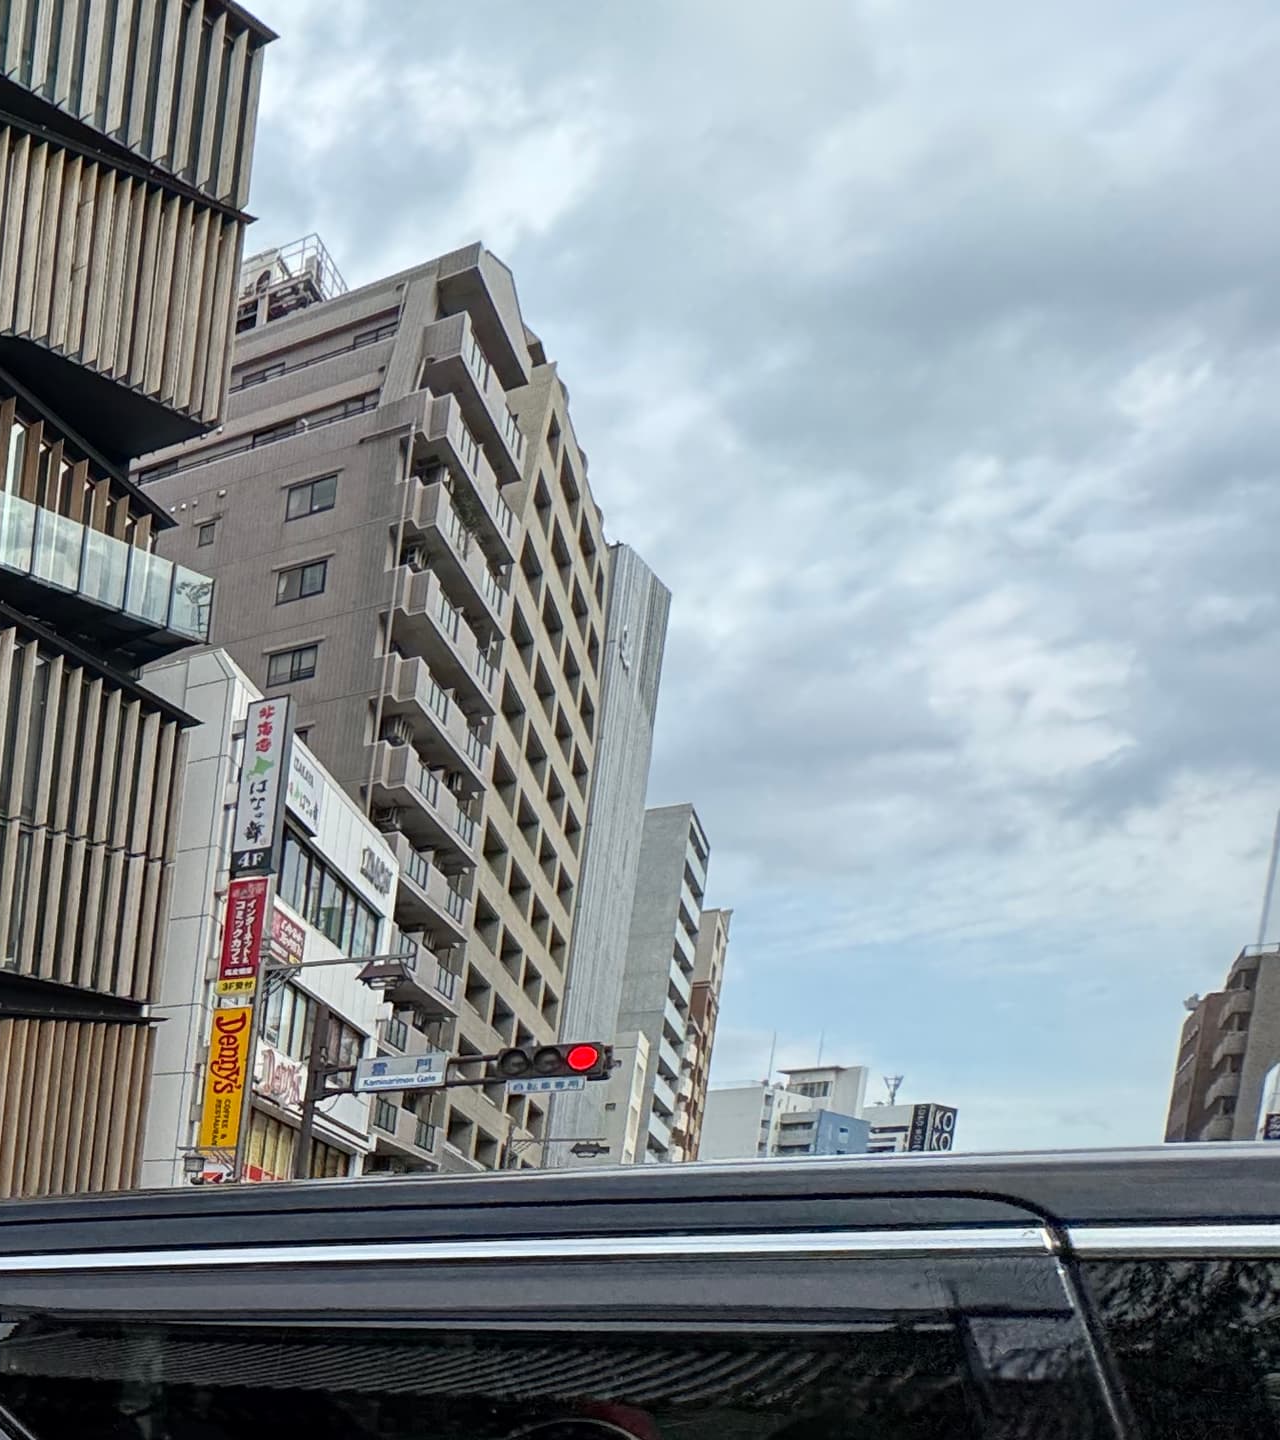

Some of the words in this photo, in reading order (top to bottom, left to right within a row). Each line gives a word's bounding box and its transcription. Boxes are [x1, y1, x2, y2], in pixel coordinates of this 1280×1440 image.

[238, 852, 264, 868] 4F
[210, 1011, 247, 1094] Denny's
[934, 1110, 954, 1131] KO
[931, 1130, 951, 1151] KO
